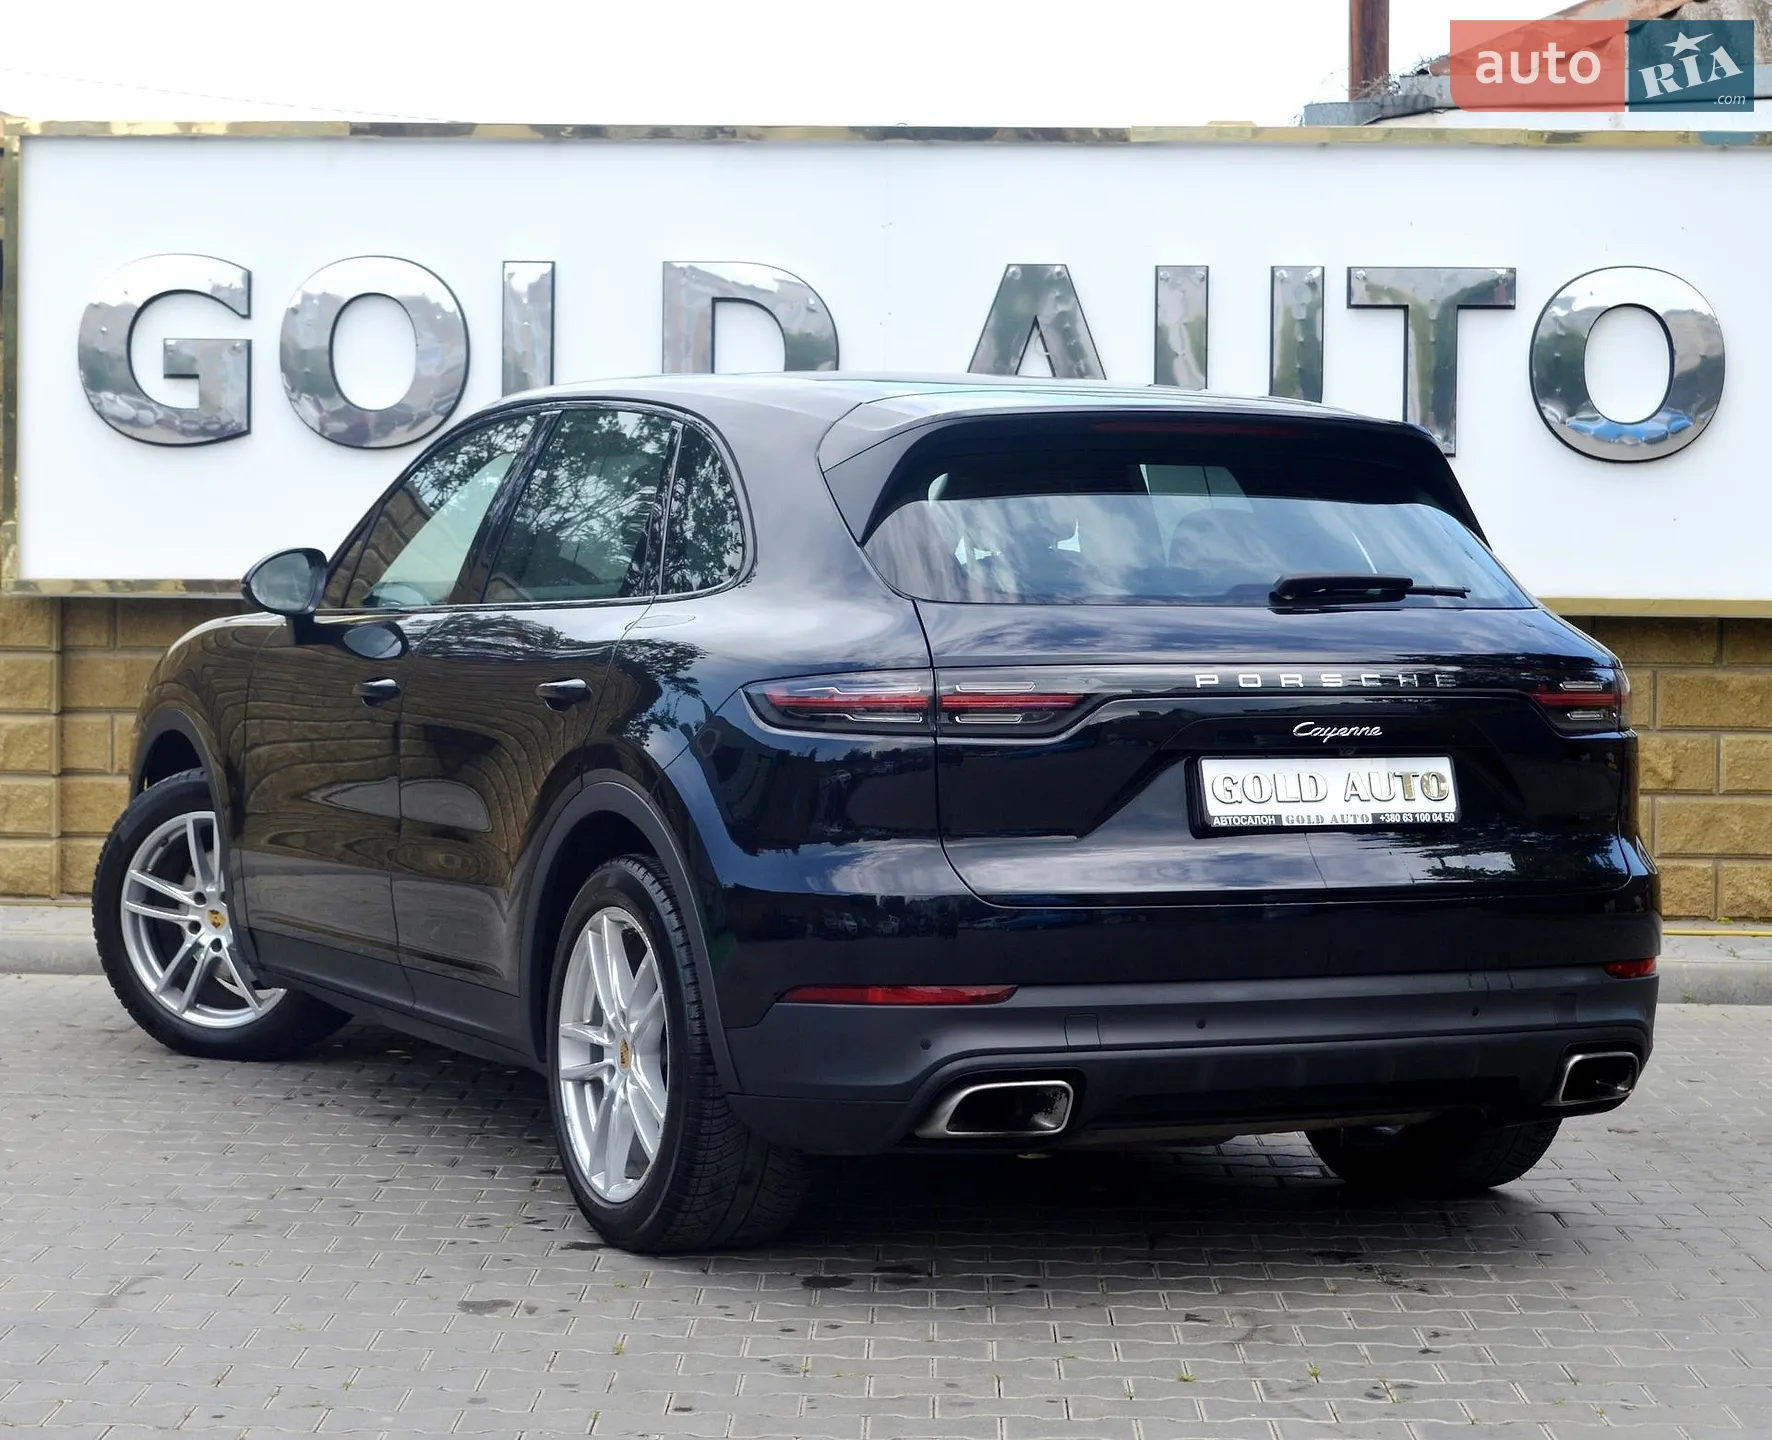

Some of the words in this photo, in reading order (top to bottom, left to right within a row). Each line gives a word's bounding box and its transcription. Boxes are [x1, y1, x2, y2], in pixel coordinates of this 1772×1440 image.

[1195, 673, 1457, 688] PORSCHE
[1293, 721, 1383, 743] Cayenne
[1211, 771, 1328, 804] GOLD
[1344, 771, 1450, 802] AUTO
[1213, 815, 1276, 826] АВТОСАЛОН
[1285, 814, 1325, 825] GOLD
[1330, 813, 1370, 824] AUTO
[1379, 813, 1400, 823] +380
[1402, 813, 1413, 822] 63
[1415, 813, 1430, 822] 100
[1432, 813, 1443, 822] 04
[1444, 812, 1455, 821] 50
